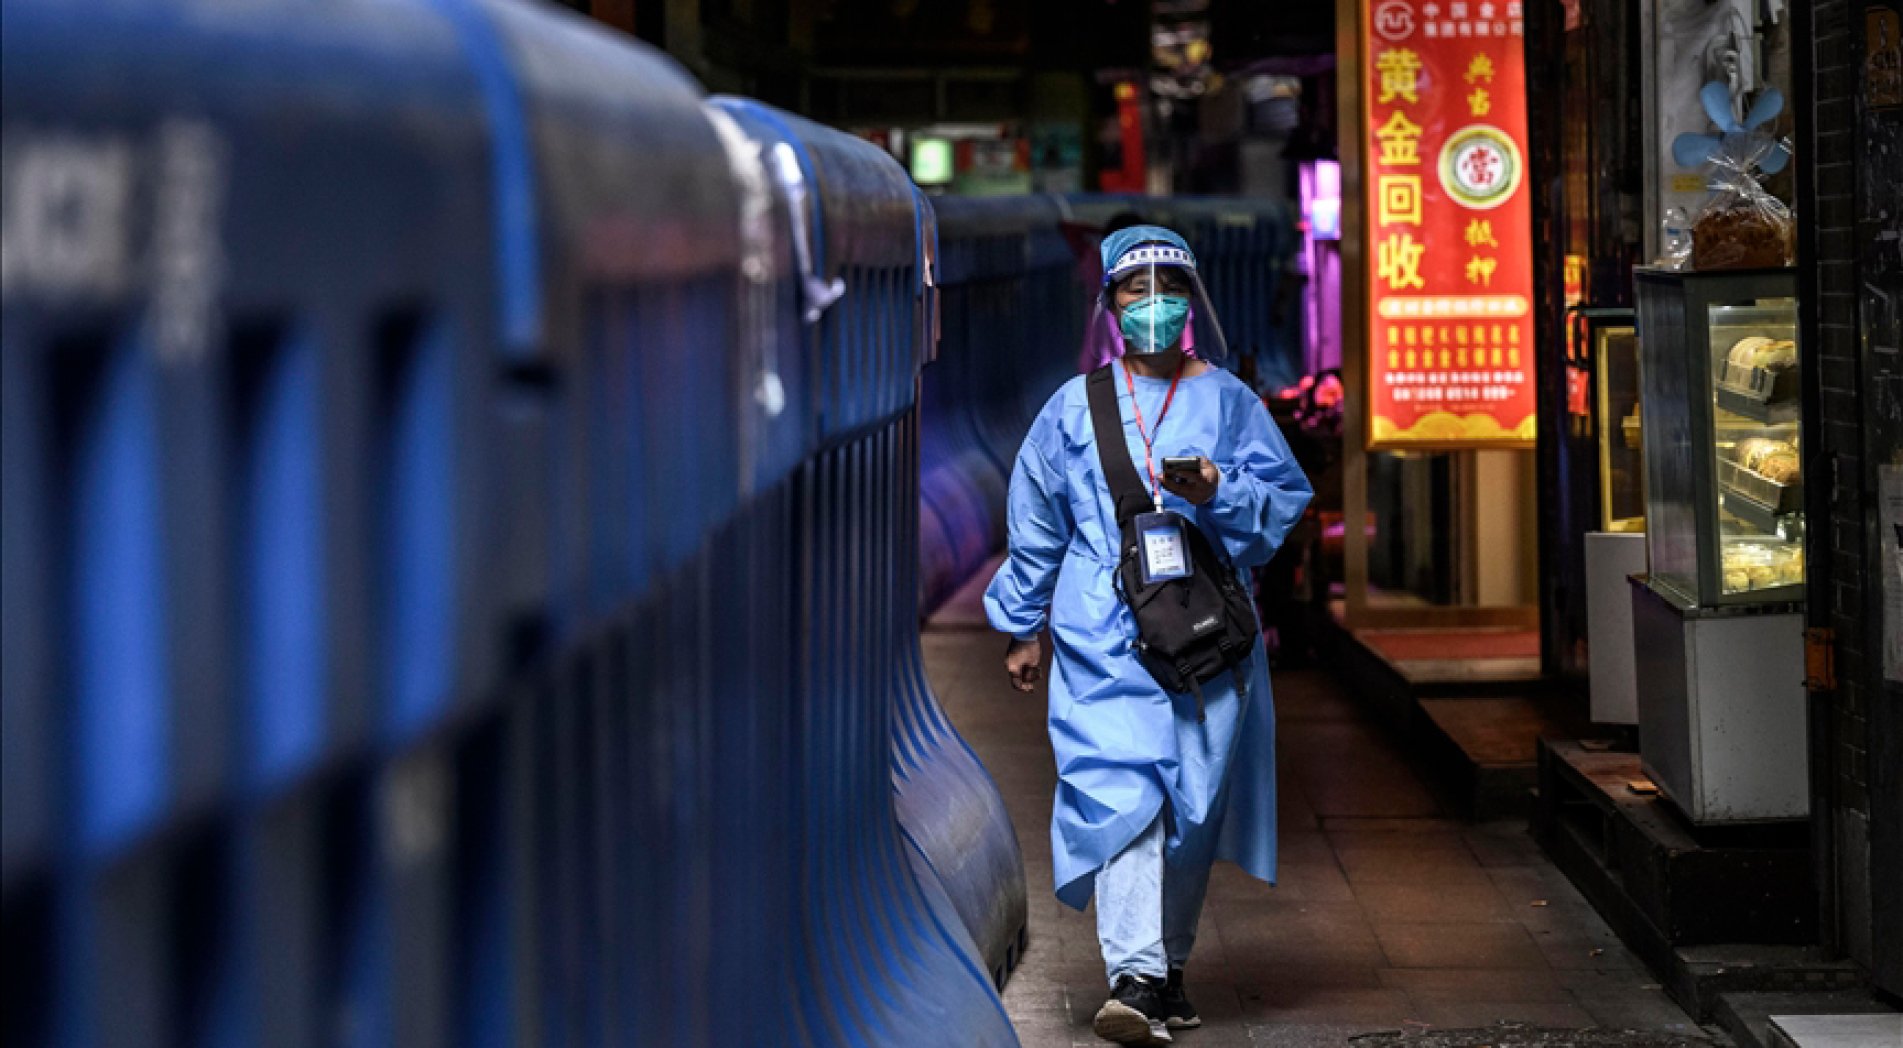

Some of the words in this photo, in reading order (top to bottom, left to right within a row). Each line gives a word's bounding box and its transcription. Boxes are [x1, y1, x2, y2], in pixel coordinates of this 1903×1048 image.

[1376, 48, 1425, 289] 黄金回收
[1464, 218, 1498, 288] 抵押
